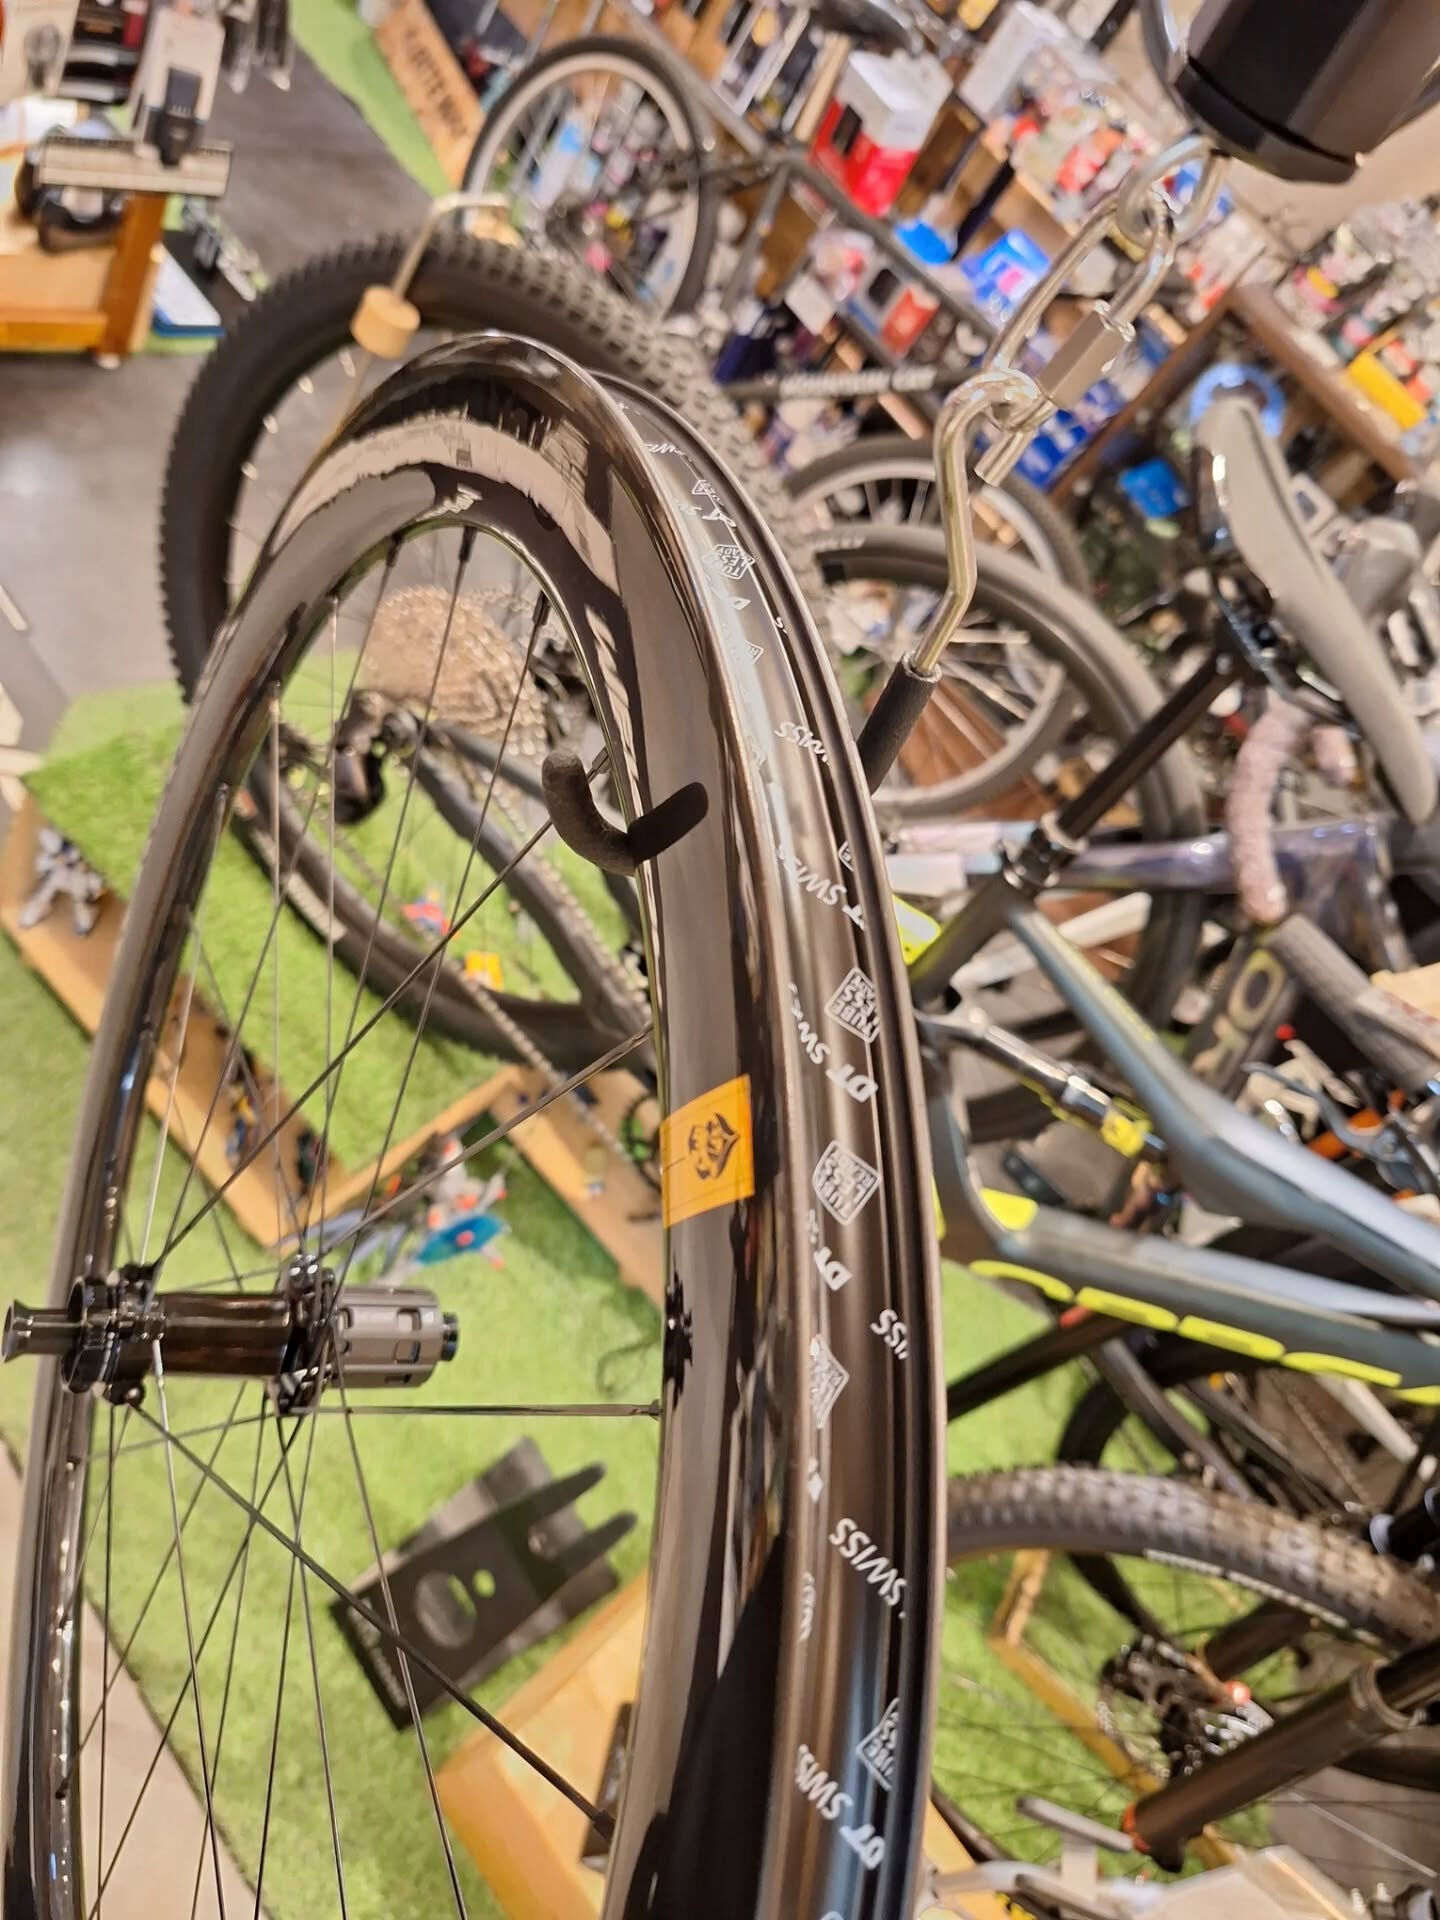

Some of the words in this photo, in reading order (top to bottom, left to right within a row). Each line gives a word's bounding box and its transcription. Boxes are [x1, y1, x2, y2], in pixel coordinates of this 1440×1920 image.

[825, 1064, 879, 1103] DT
[814, 1247, 853, 1291] DT
[829, 1517, 907, 1606] SWISS
[840, 1823, 885, 1870] DT
